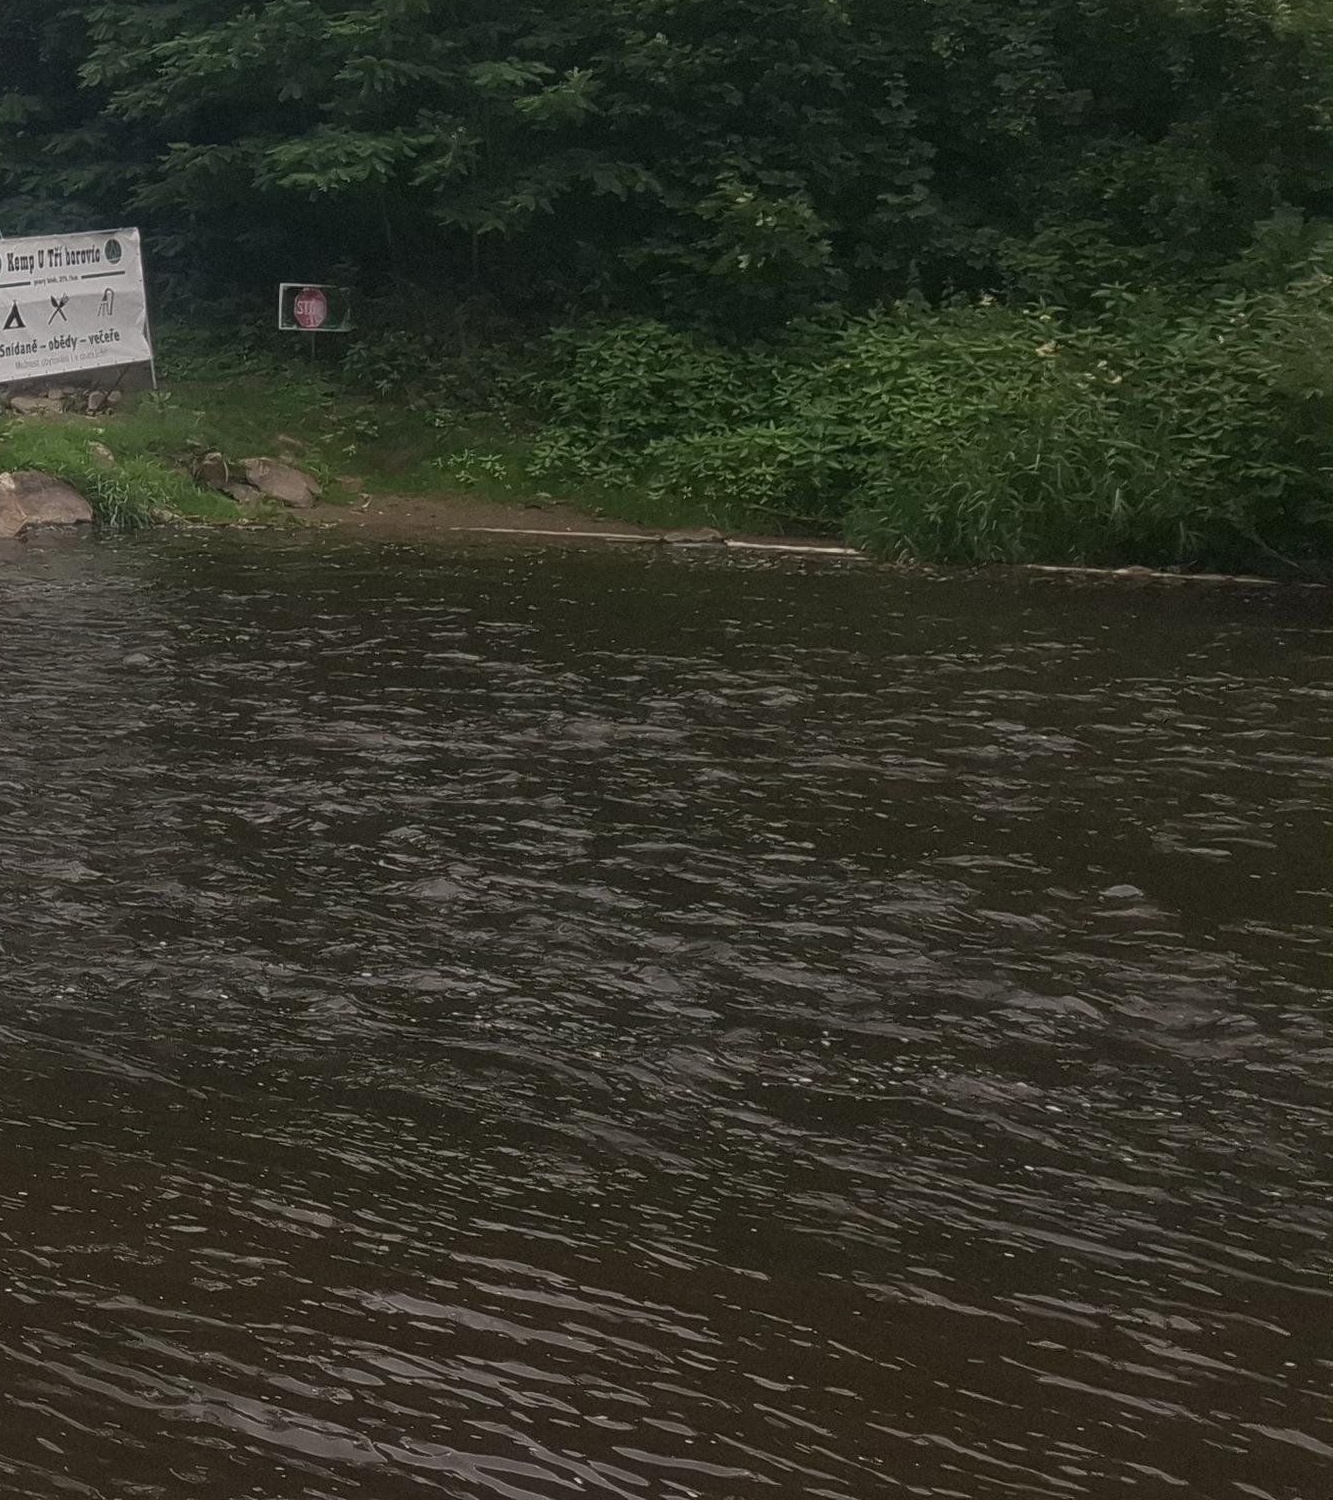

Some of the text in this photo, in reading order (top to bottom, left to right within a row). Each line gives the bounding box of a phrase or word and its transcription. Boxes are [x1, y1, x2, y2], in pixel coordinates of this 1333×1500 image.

[6, 244, 101, 274] Kemp U Tří borovic
[0, 339, 38, 358] Snídaně
[48, 334, 78, 351] obědy
[88, 328, 121, 345] večeře
